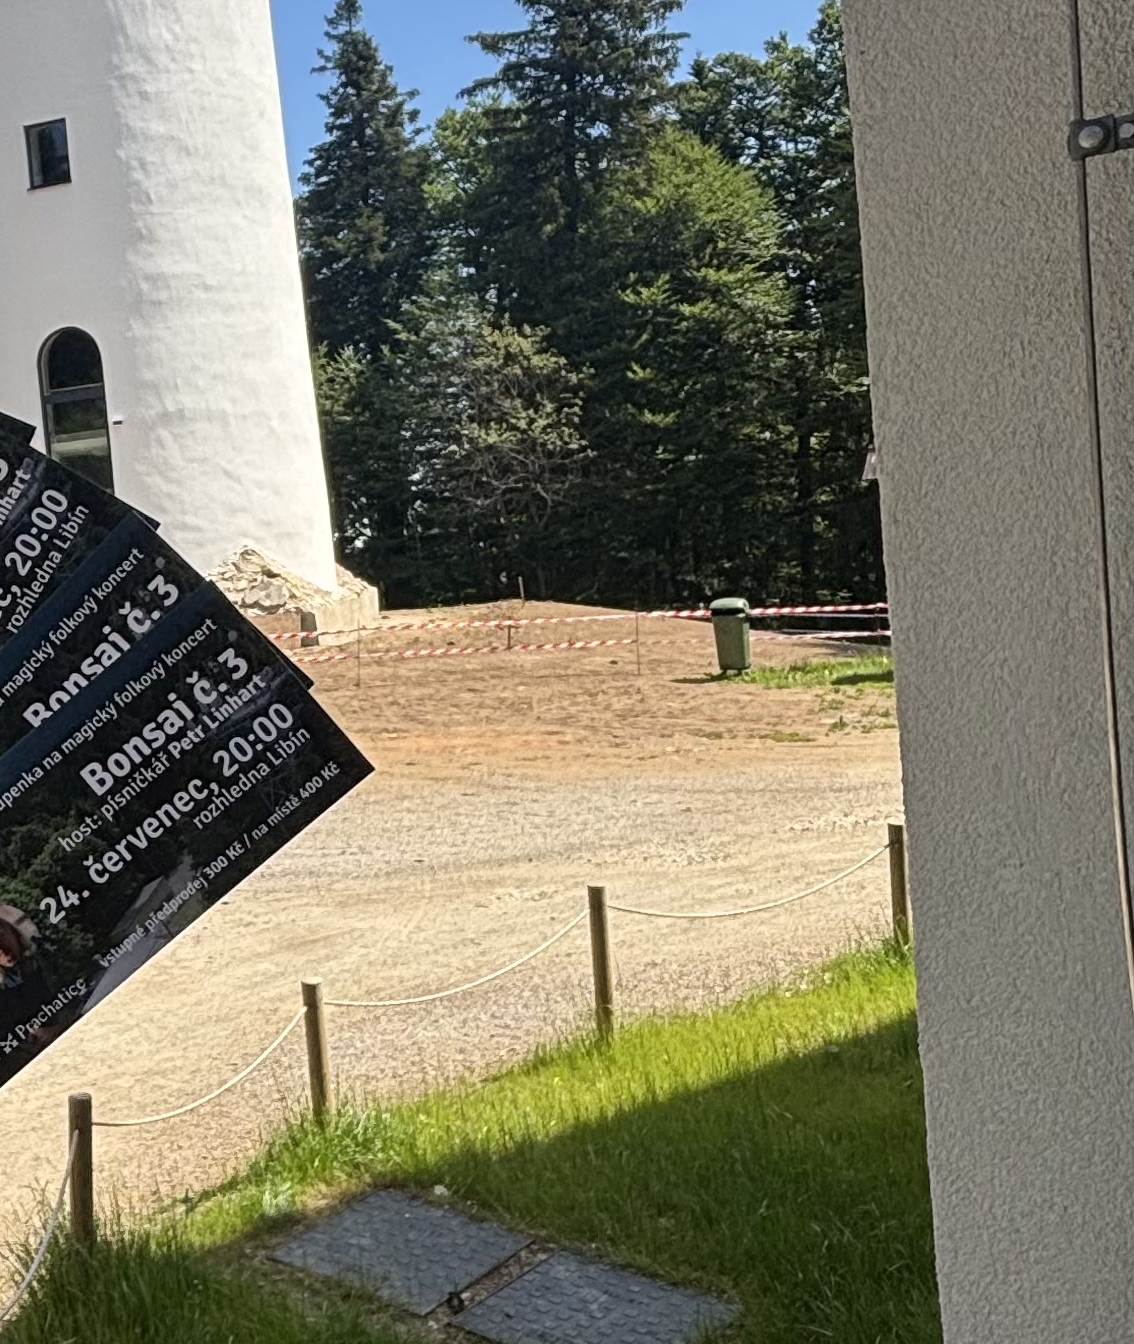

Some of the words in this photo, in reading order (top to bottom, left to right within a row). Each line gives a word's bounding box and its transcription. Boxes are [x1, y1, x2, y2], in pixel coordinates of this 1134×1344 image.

[4, 489, 68, 577] 20:00
[6, 550, 63, 634] rozhledna
[52, 505, 89, 549] Libín
[118, 601, 161, 635] č.
[147, 574, 179, 607] 3
[1, 640, 55, 697] magický
[48, 595, 98, 645] folkový
[91, 548, 144, 600] koncert
[42, 751, 63, 770] na
[60, 701, 118, 754] magický
[113, 660, 166, 708] folkový
[160, 618, 218, 667] koncert
[57, 815, 102, 852] host:
[100, 751, 170, 822] písničkář
[167, 724, 206, 759] Petr
[201, 674, 267, 730] Linhart
[79, 692, 195, 796] Bonsai
[185, 670, 228, 705] č.
[217, 647, 248, 680] 3
[192, 762, 271, 830] rozhledna
[266, 728, 311, 766] Libín
[39, 885, 90, 925] 24.
[82, 778, 219, 884] červenec,
[212, 703, 294, 777] 20:00
[100, 927, 144, 967] vstupné
[145, 877, 208, 933] předprodej
[203, 855, 228, 879] 300
[225, 841, 245, 860] Kč
[252, 824, 269, 840] na
[267, 795, 301, 826] místě
[299, 776, 323, 798] 400
[320, 761, 340, 781] Kč
